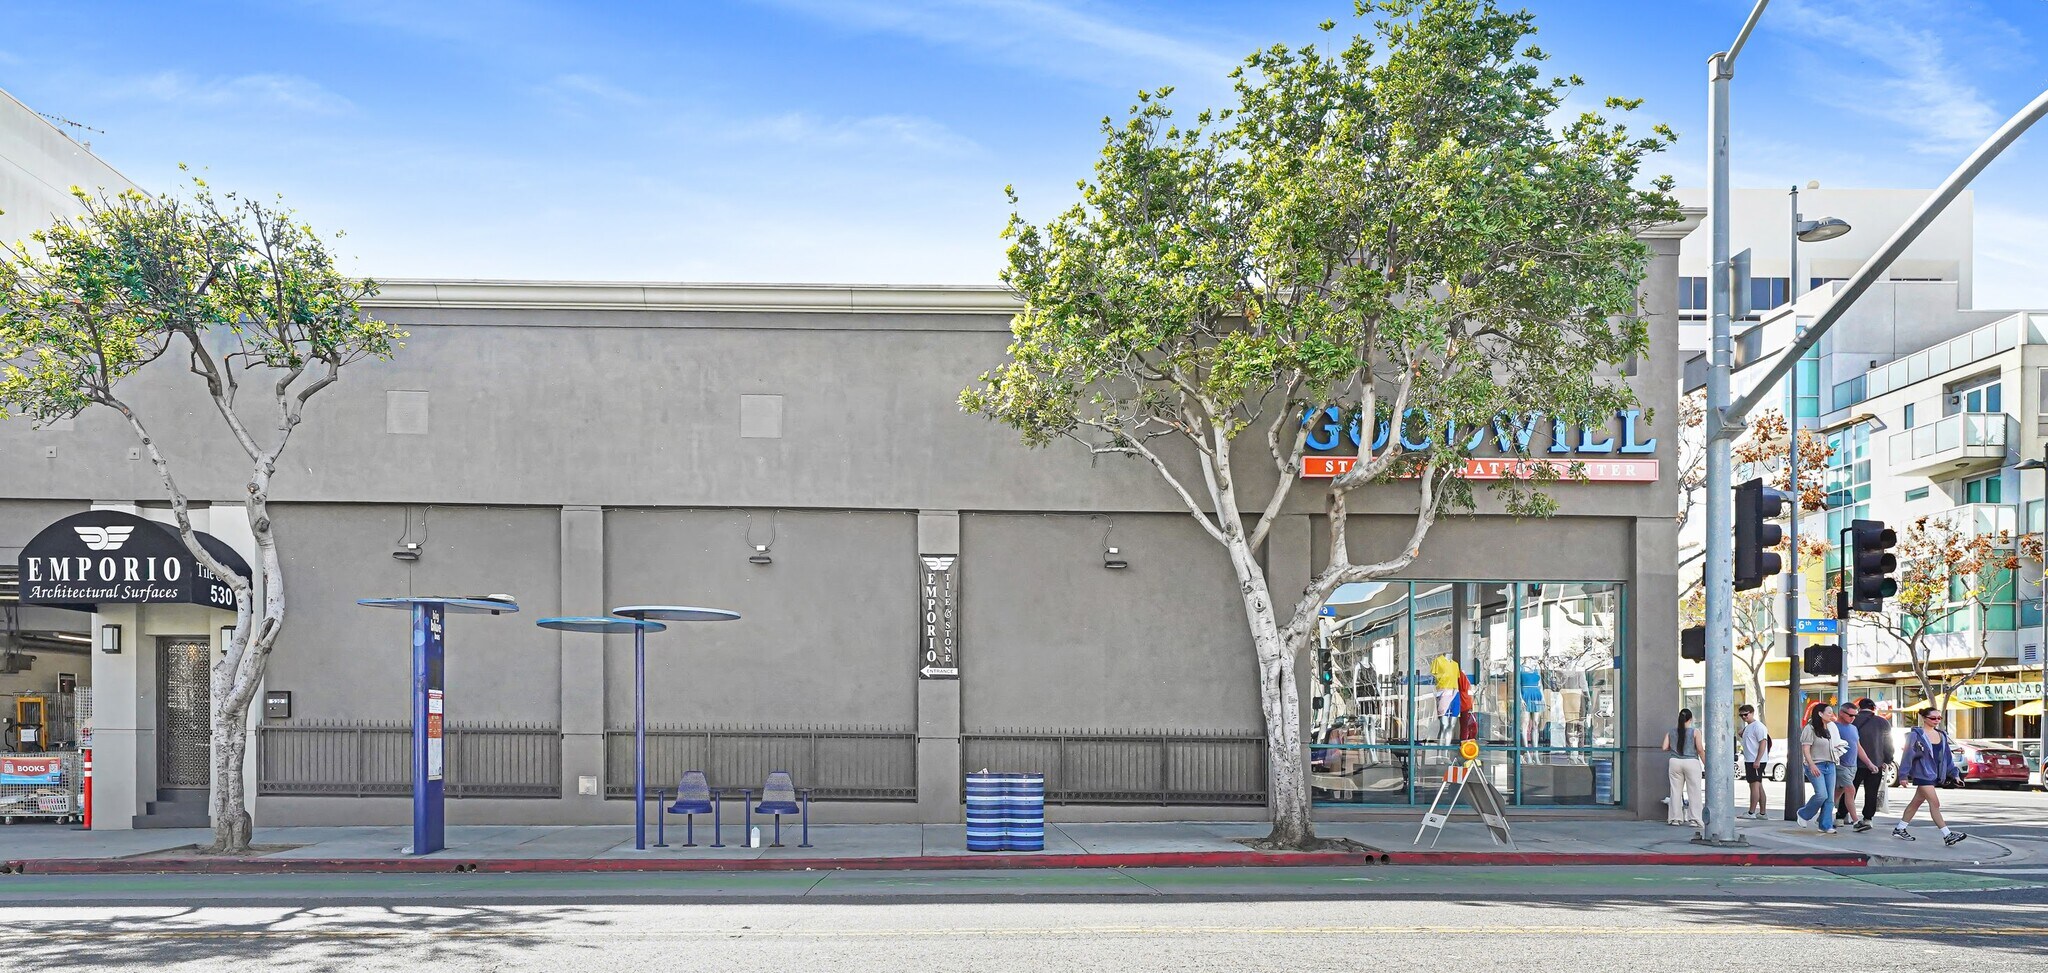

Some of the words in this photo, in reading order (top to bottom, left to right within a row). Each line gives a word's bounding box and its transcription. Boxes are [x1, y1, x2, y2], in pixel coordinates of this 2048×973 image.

[1552, 463, 1637, 477] CNTER
[27, 556, 181, 582] EMPORIO
[29, 583, 119, 599] Architectural
[121, 584, 178, 602] Surfaces
[210, 584, 233, 606] 530
[926, 573, 937, 662] EMPORIO
[944, 608, 953, 619] &
[1798, 620, 1811, 630] 6th
[944, 621, 952, 662] STONE
[1964, 684, 2042, 696] MARMALAD
